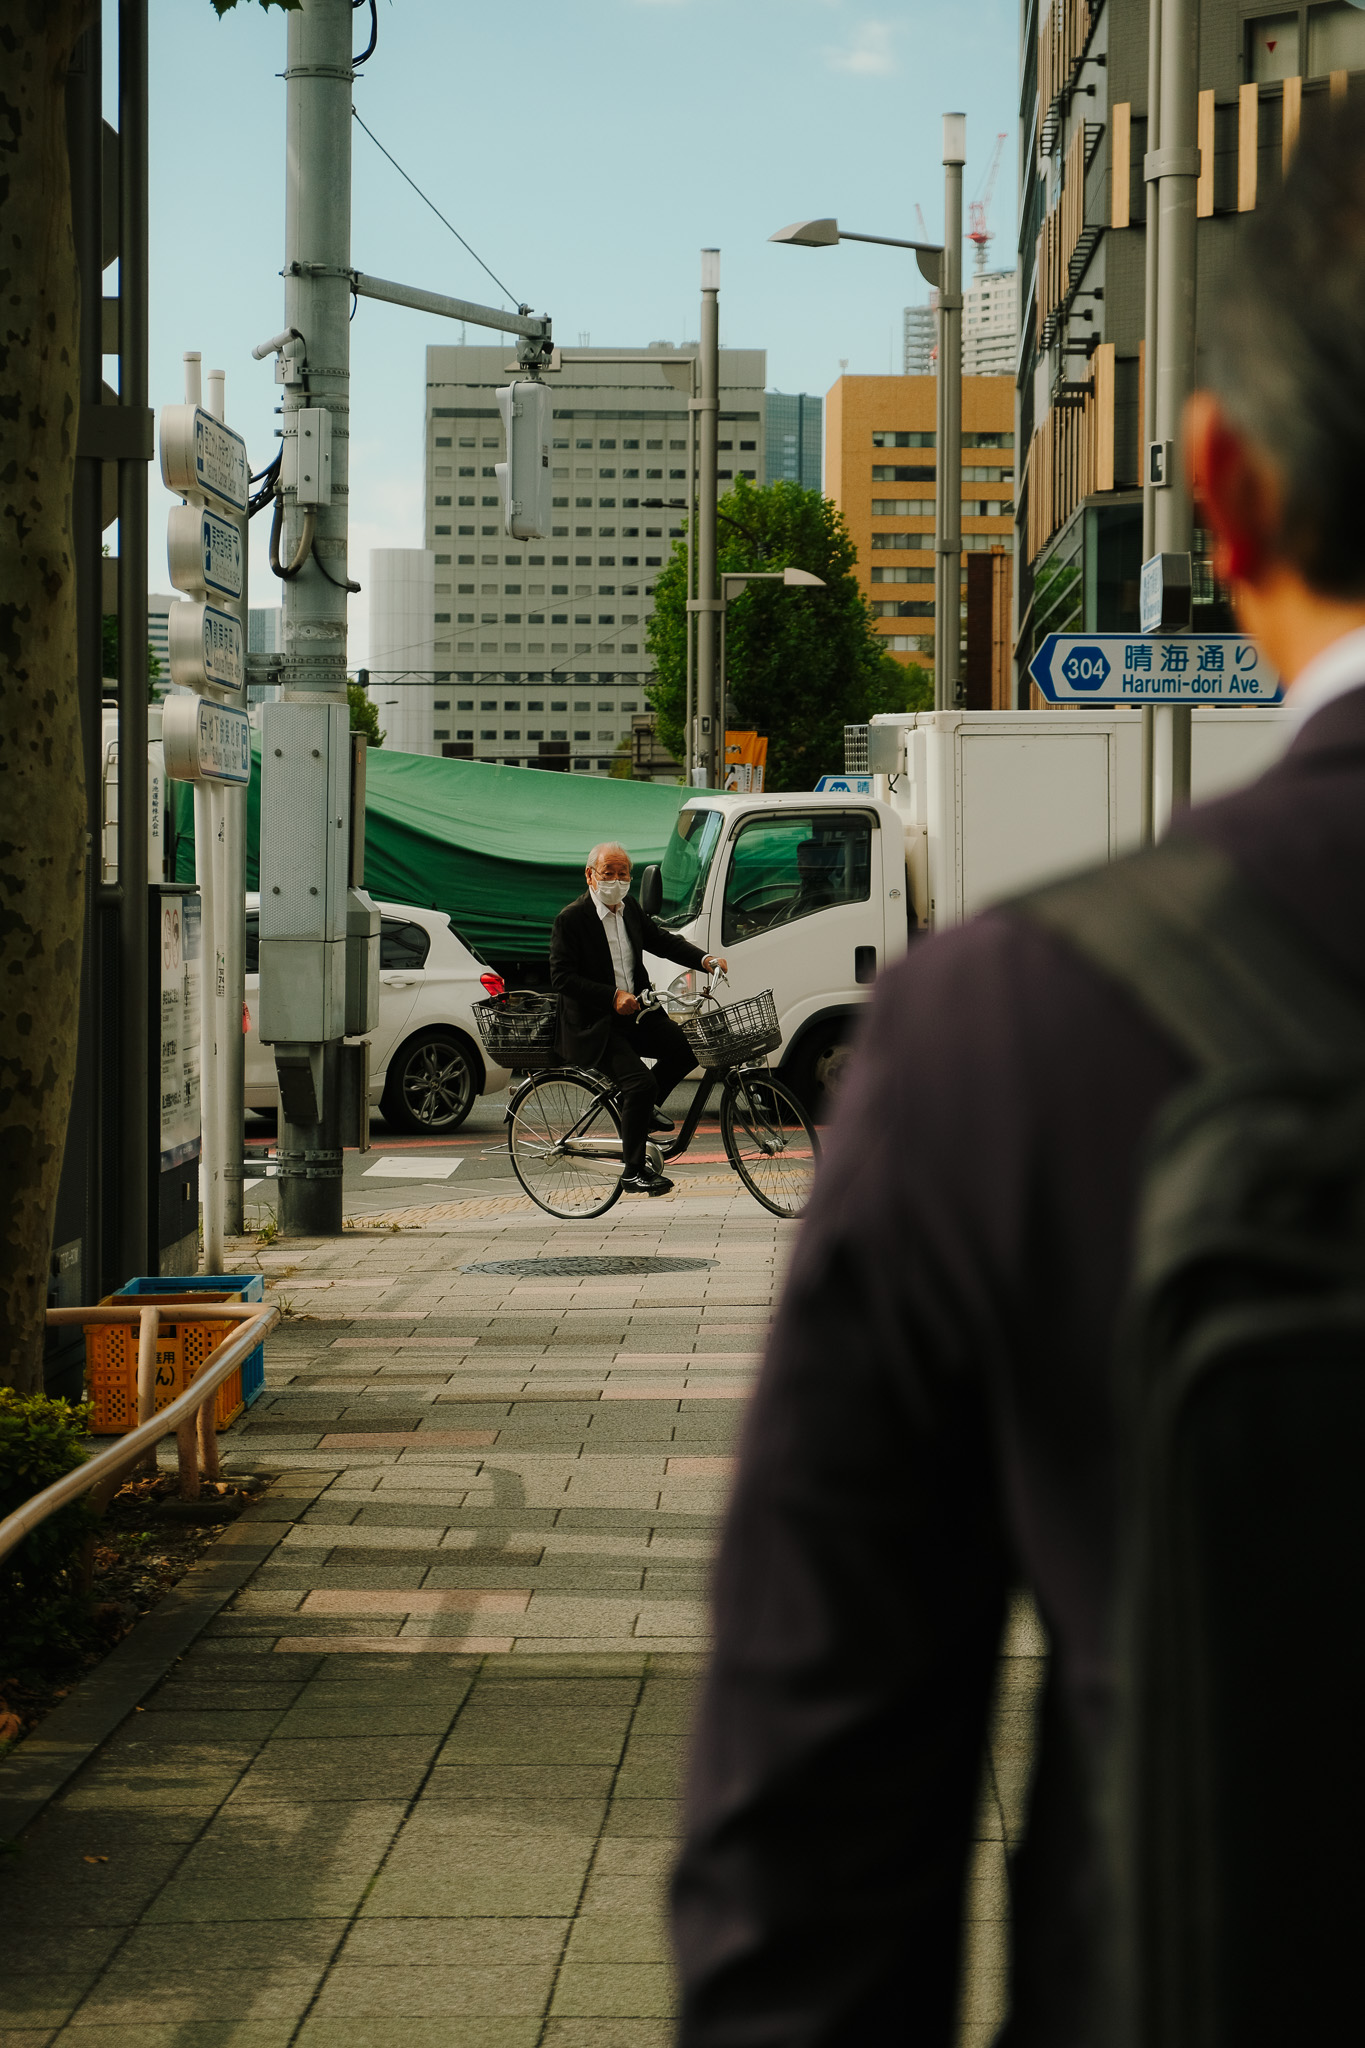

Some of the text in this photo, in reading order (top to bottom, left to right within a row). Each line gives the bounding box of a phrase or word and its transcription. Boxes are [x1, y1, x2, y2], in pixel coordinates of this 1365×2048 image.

[1067, 657, 1105, 680] 304
[1124, 644, 1258, 672] 晴海通り
[1122, 674, 1263, 693] Harumi-dori Ave.
